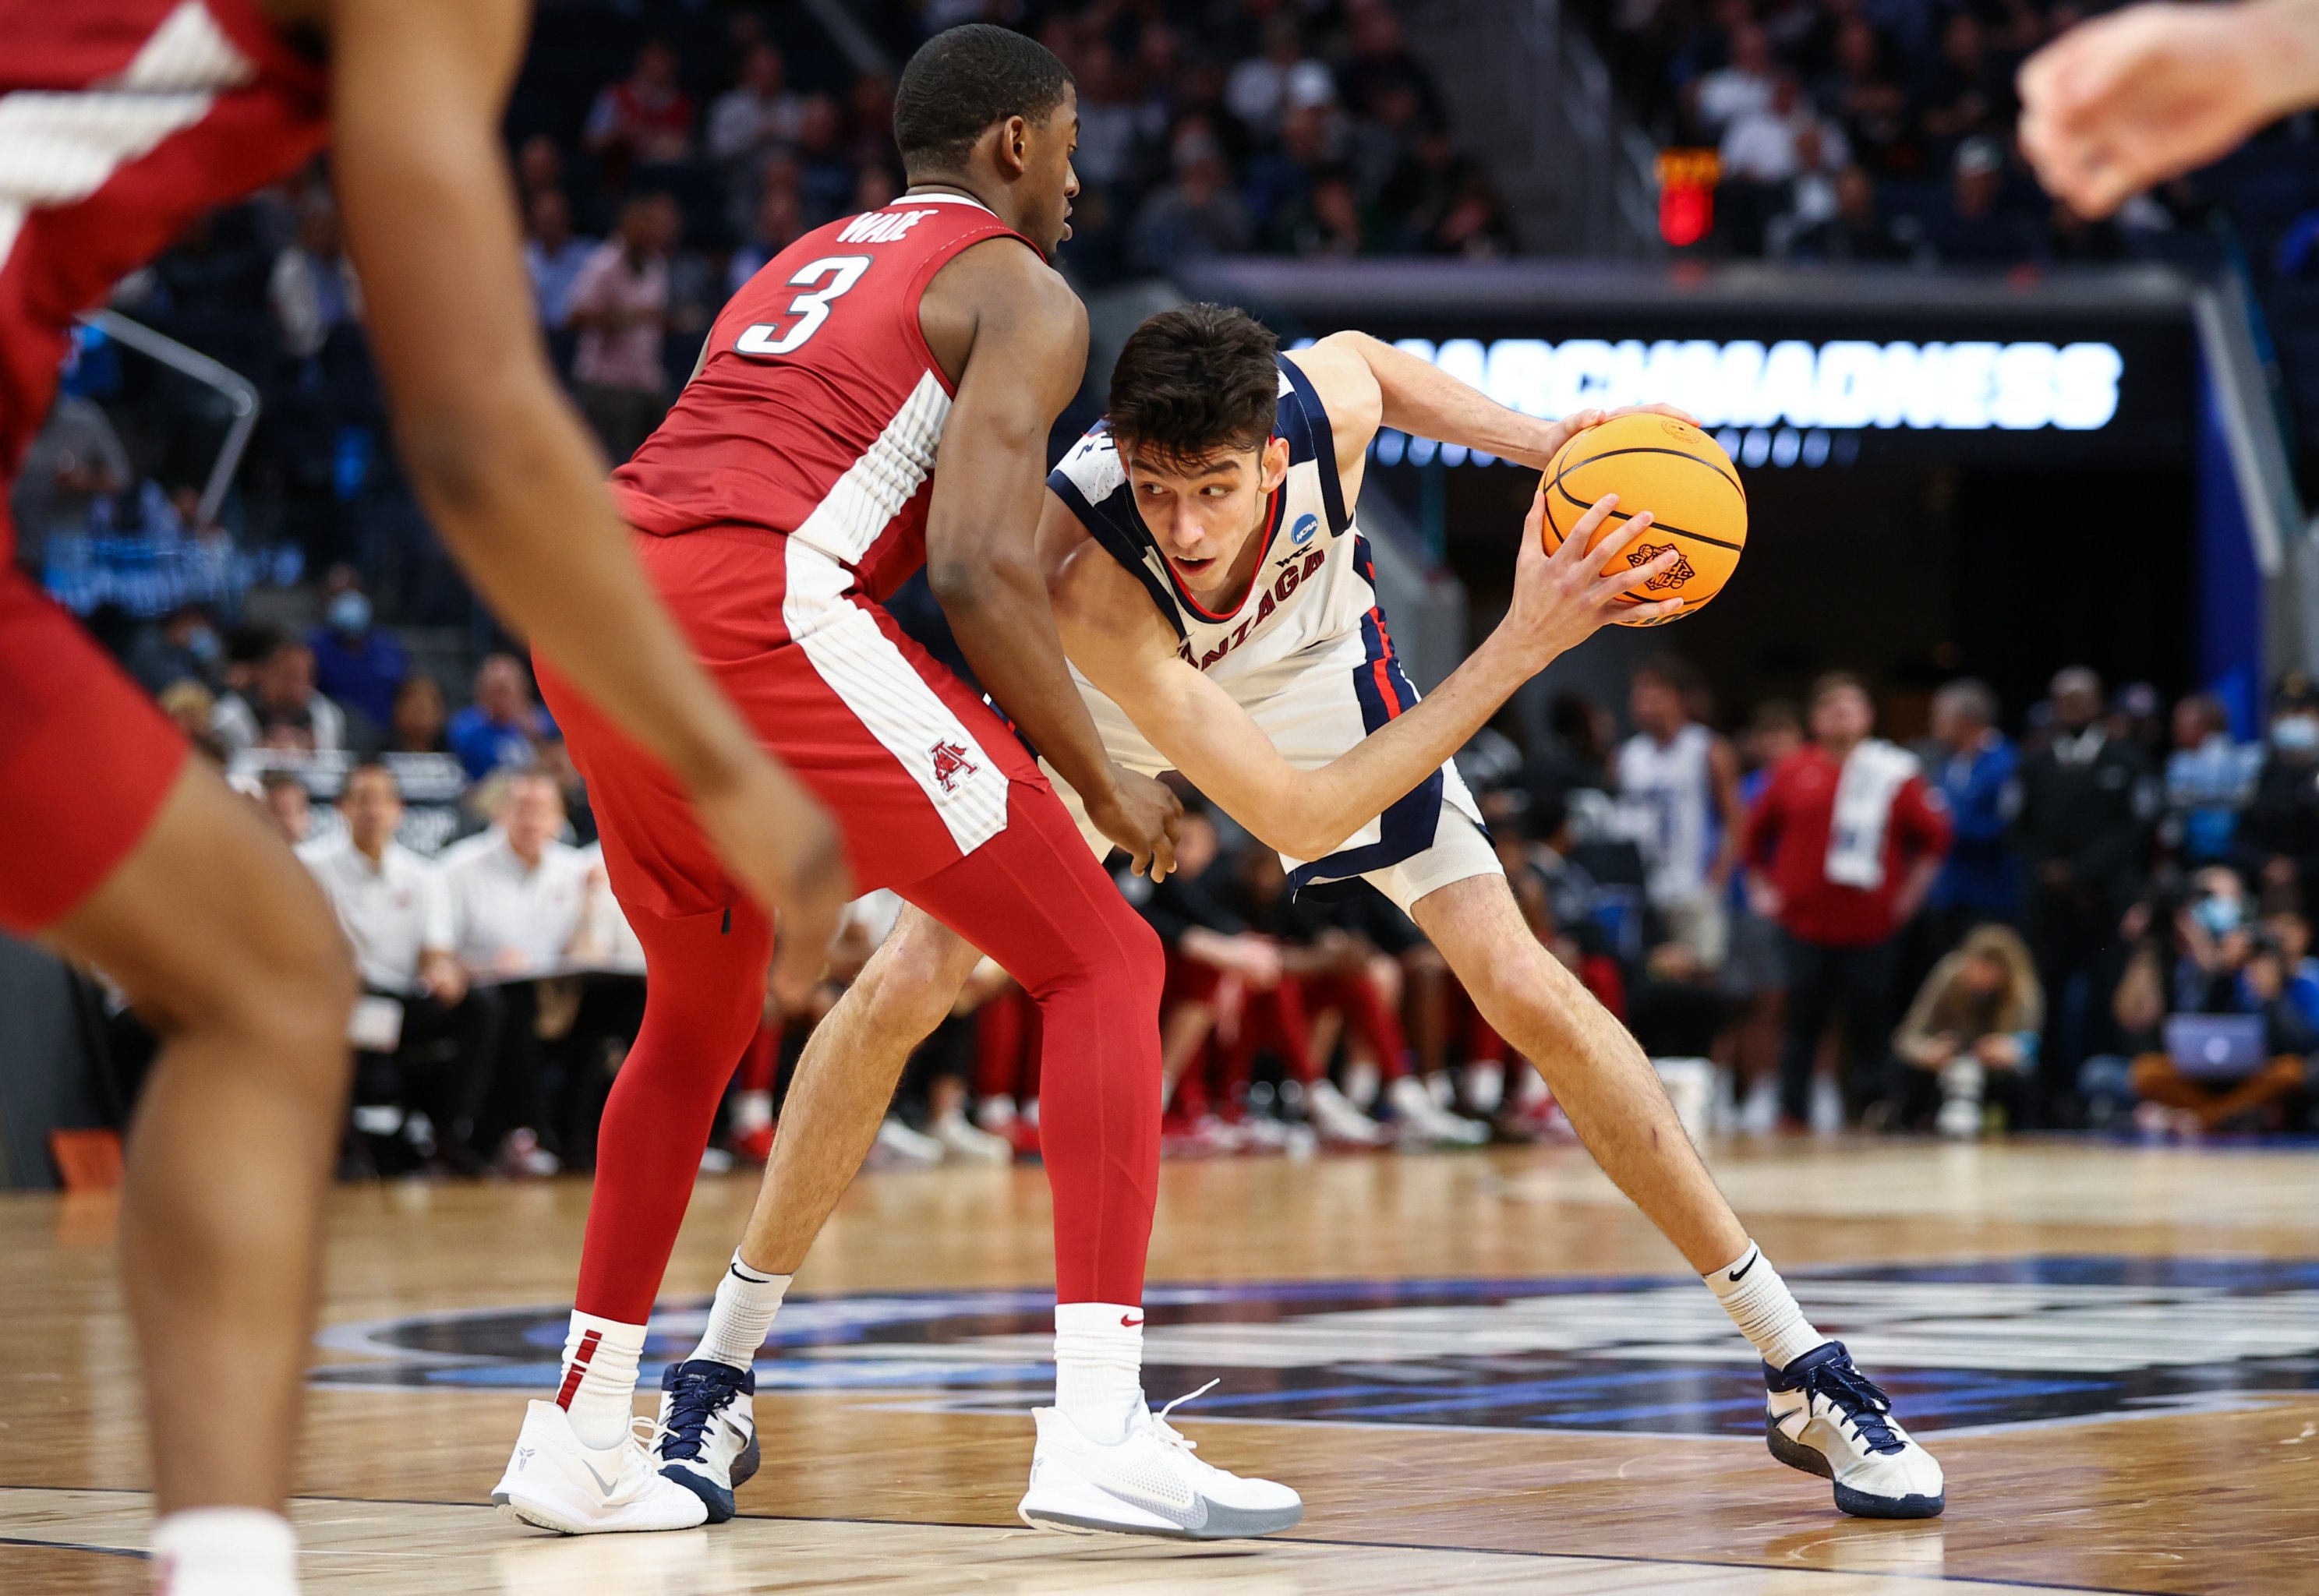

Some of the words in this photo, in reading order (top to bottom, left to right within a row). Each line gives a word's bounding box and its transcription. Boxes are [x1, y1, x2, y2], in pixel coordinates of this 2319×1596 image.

[836, 209, 939, 243] WADE
[732, 253, 874, 355] 3
[1295, 520, 1318, 542] NCAA
[1177, 549, 1325, 672] NZAGA
